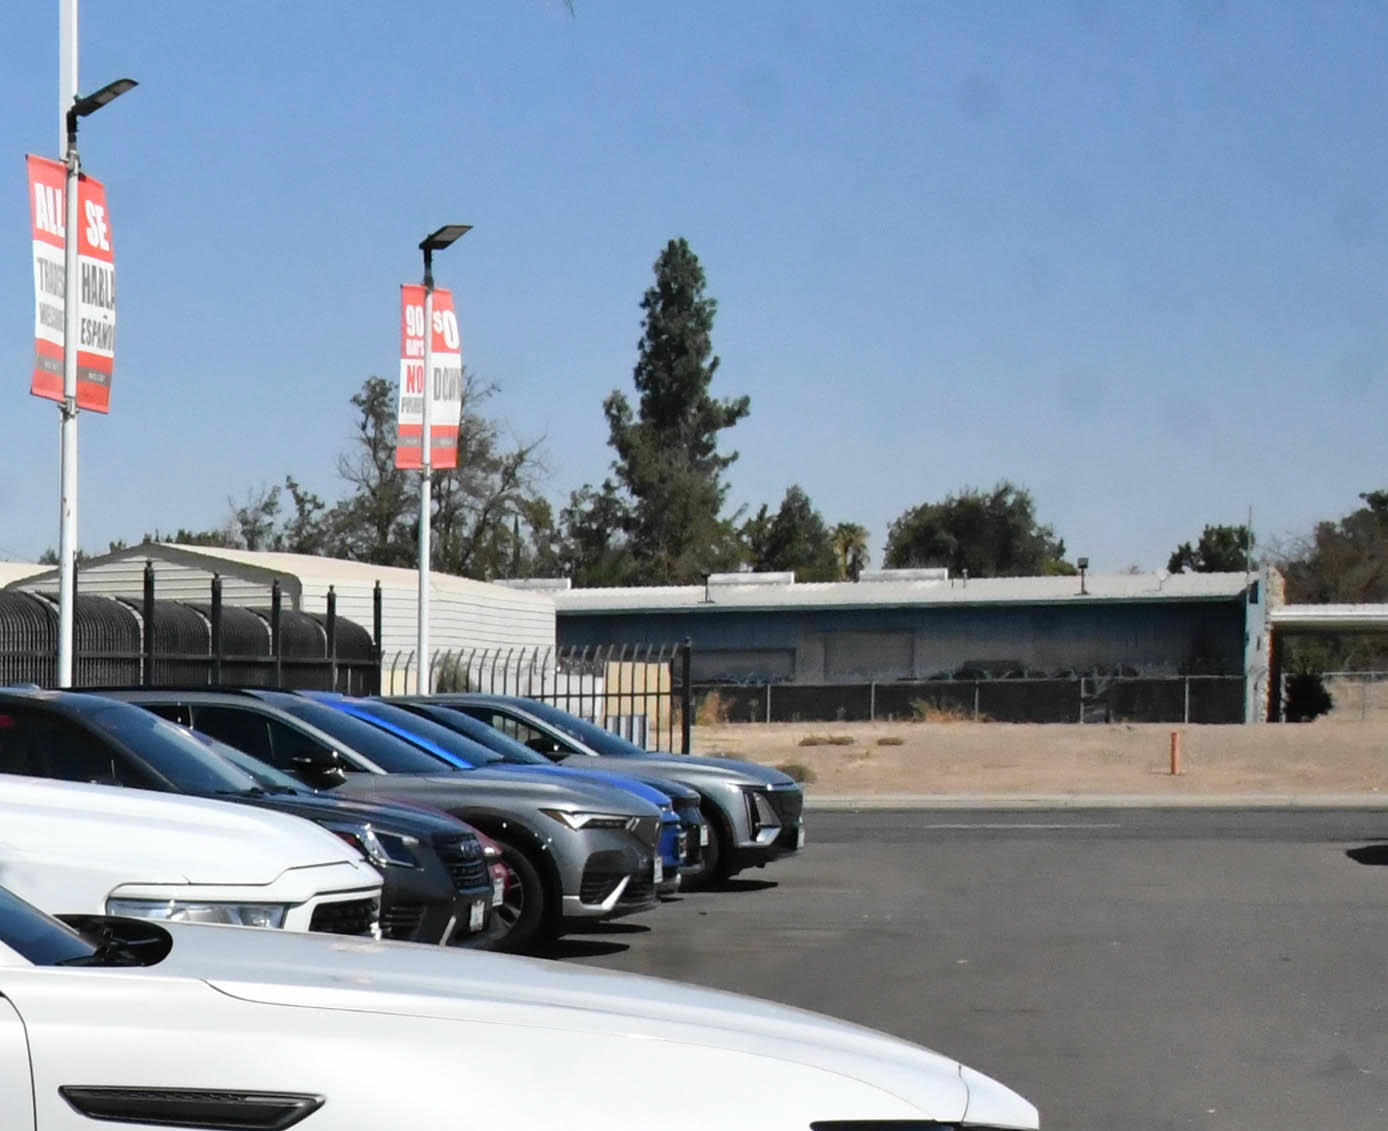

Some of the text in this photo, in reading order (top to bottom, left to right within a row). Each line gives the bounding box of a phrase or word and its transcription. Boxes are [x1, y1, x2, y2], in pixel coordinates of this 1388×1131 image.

[33, 182, 66, 238] ALL
[85, 199, 111, 252] SE
[406, 305, 424, 337] 90
[406, 364, 424, 394] NO
